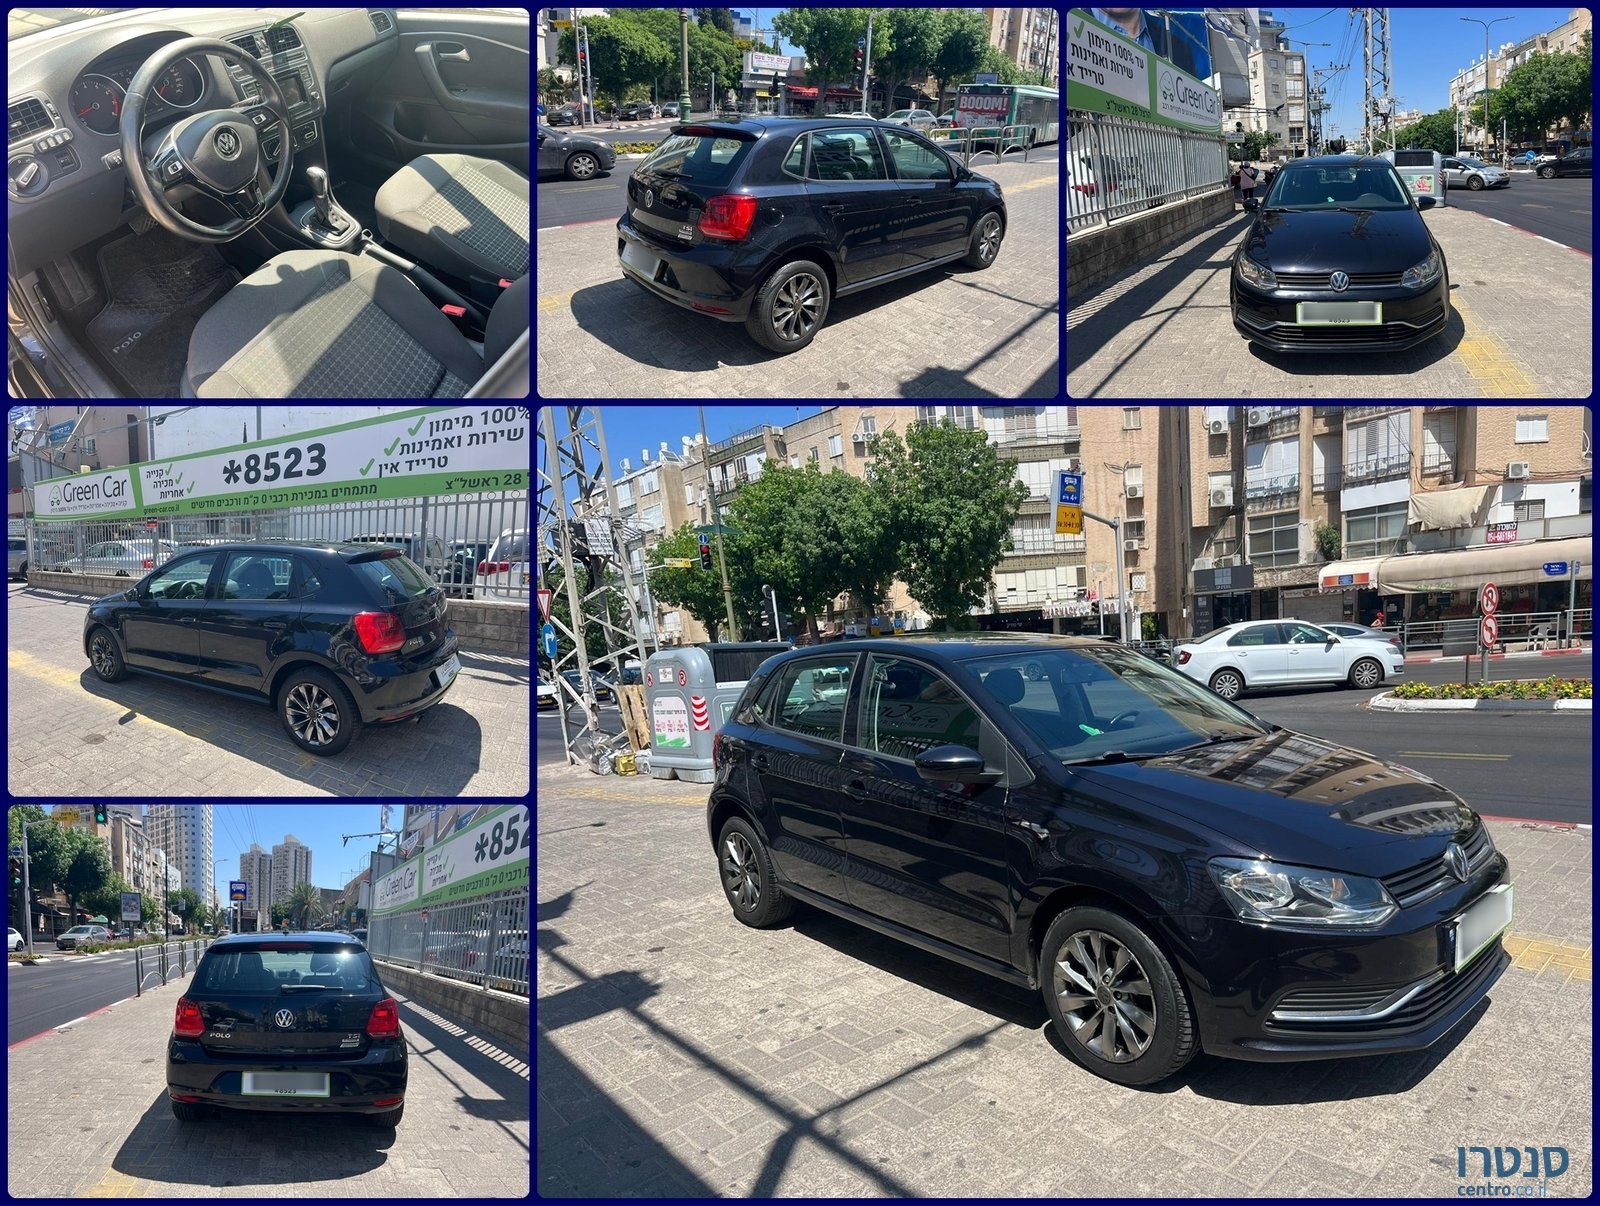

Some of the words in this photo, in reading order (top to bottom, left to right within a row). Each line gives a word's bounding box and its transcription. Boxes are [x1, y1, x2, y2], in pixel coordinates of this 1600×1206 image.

[1087, 31, 1111, 54] מימון
[1071, 42, 1109, 70] ואמינות
[1113, 42, 1134, 64] 100%
[1135, 55, 1144, 69] עד
[1078, 65, 1105, 86] טרייד
[1110, 62, 1134, 79] שירות
[1175, 76, 1204, 110] Green
[1204, 89, 1216, 114] Car
[959, 96, 1008, 111] BOOOM!
[1131, 105, 1138, 115] 28
[429, 415, 473, 437] מימון
[467, 427, 524, 446] שירות
[399, 435, 461, 455] ואמינות
[378, 461, 400, 478] אין
[405, 455, 449, 472] טרייד
[146, 469, 164, 479] קנייה
[503, 473, 522, 486] 28
[63, 482, 99, 503] Green
[102, 475, 127, 498] Car
[153, 479, 173, 489] מכירה
[331, 484, 377, 497] מתמחים
[160, 488, 184, 499] אחריות
[261, 494, 267, 504] 0
[269, 493, 289, 504] רכבי
[292, 487, 329, 501] במכירת
[143, 504, 180, 515] green-car.co.il
[191, 500, 215, 509] חדשים
[216, 498, 241, 508] ורכבים
[385, 876, 403, 897] Green
[403, 867, 417, 890] Car
[505, 868, 522, 882] רכבי
[209, 1031, 231, 1039] POLO
